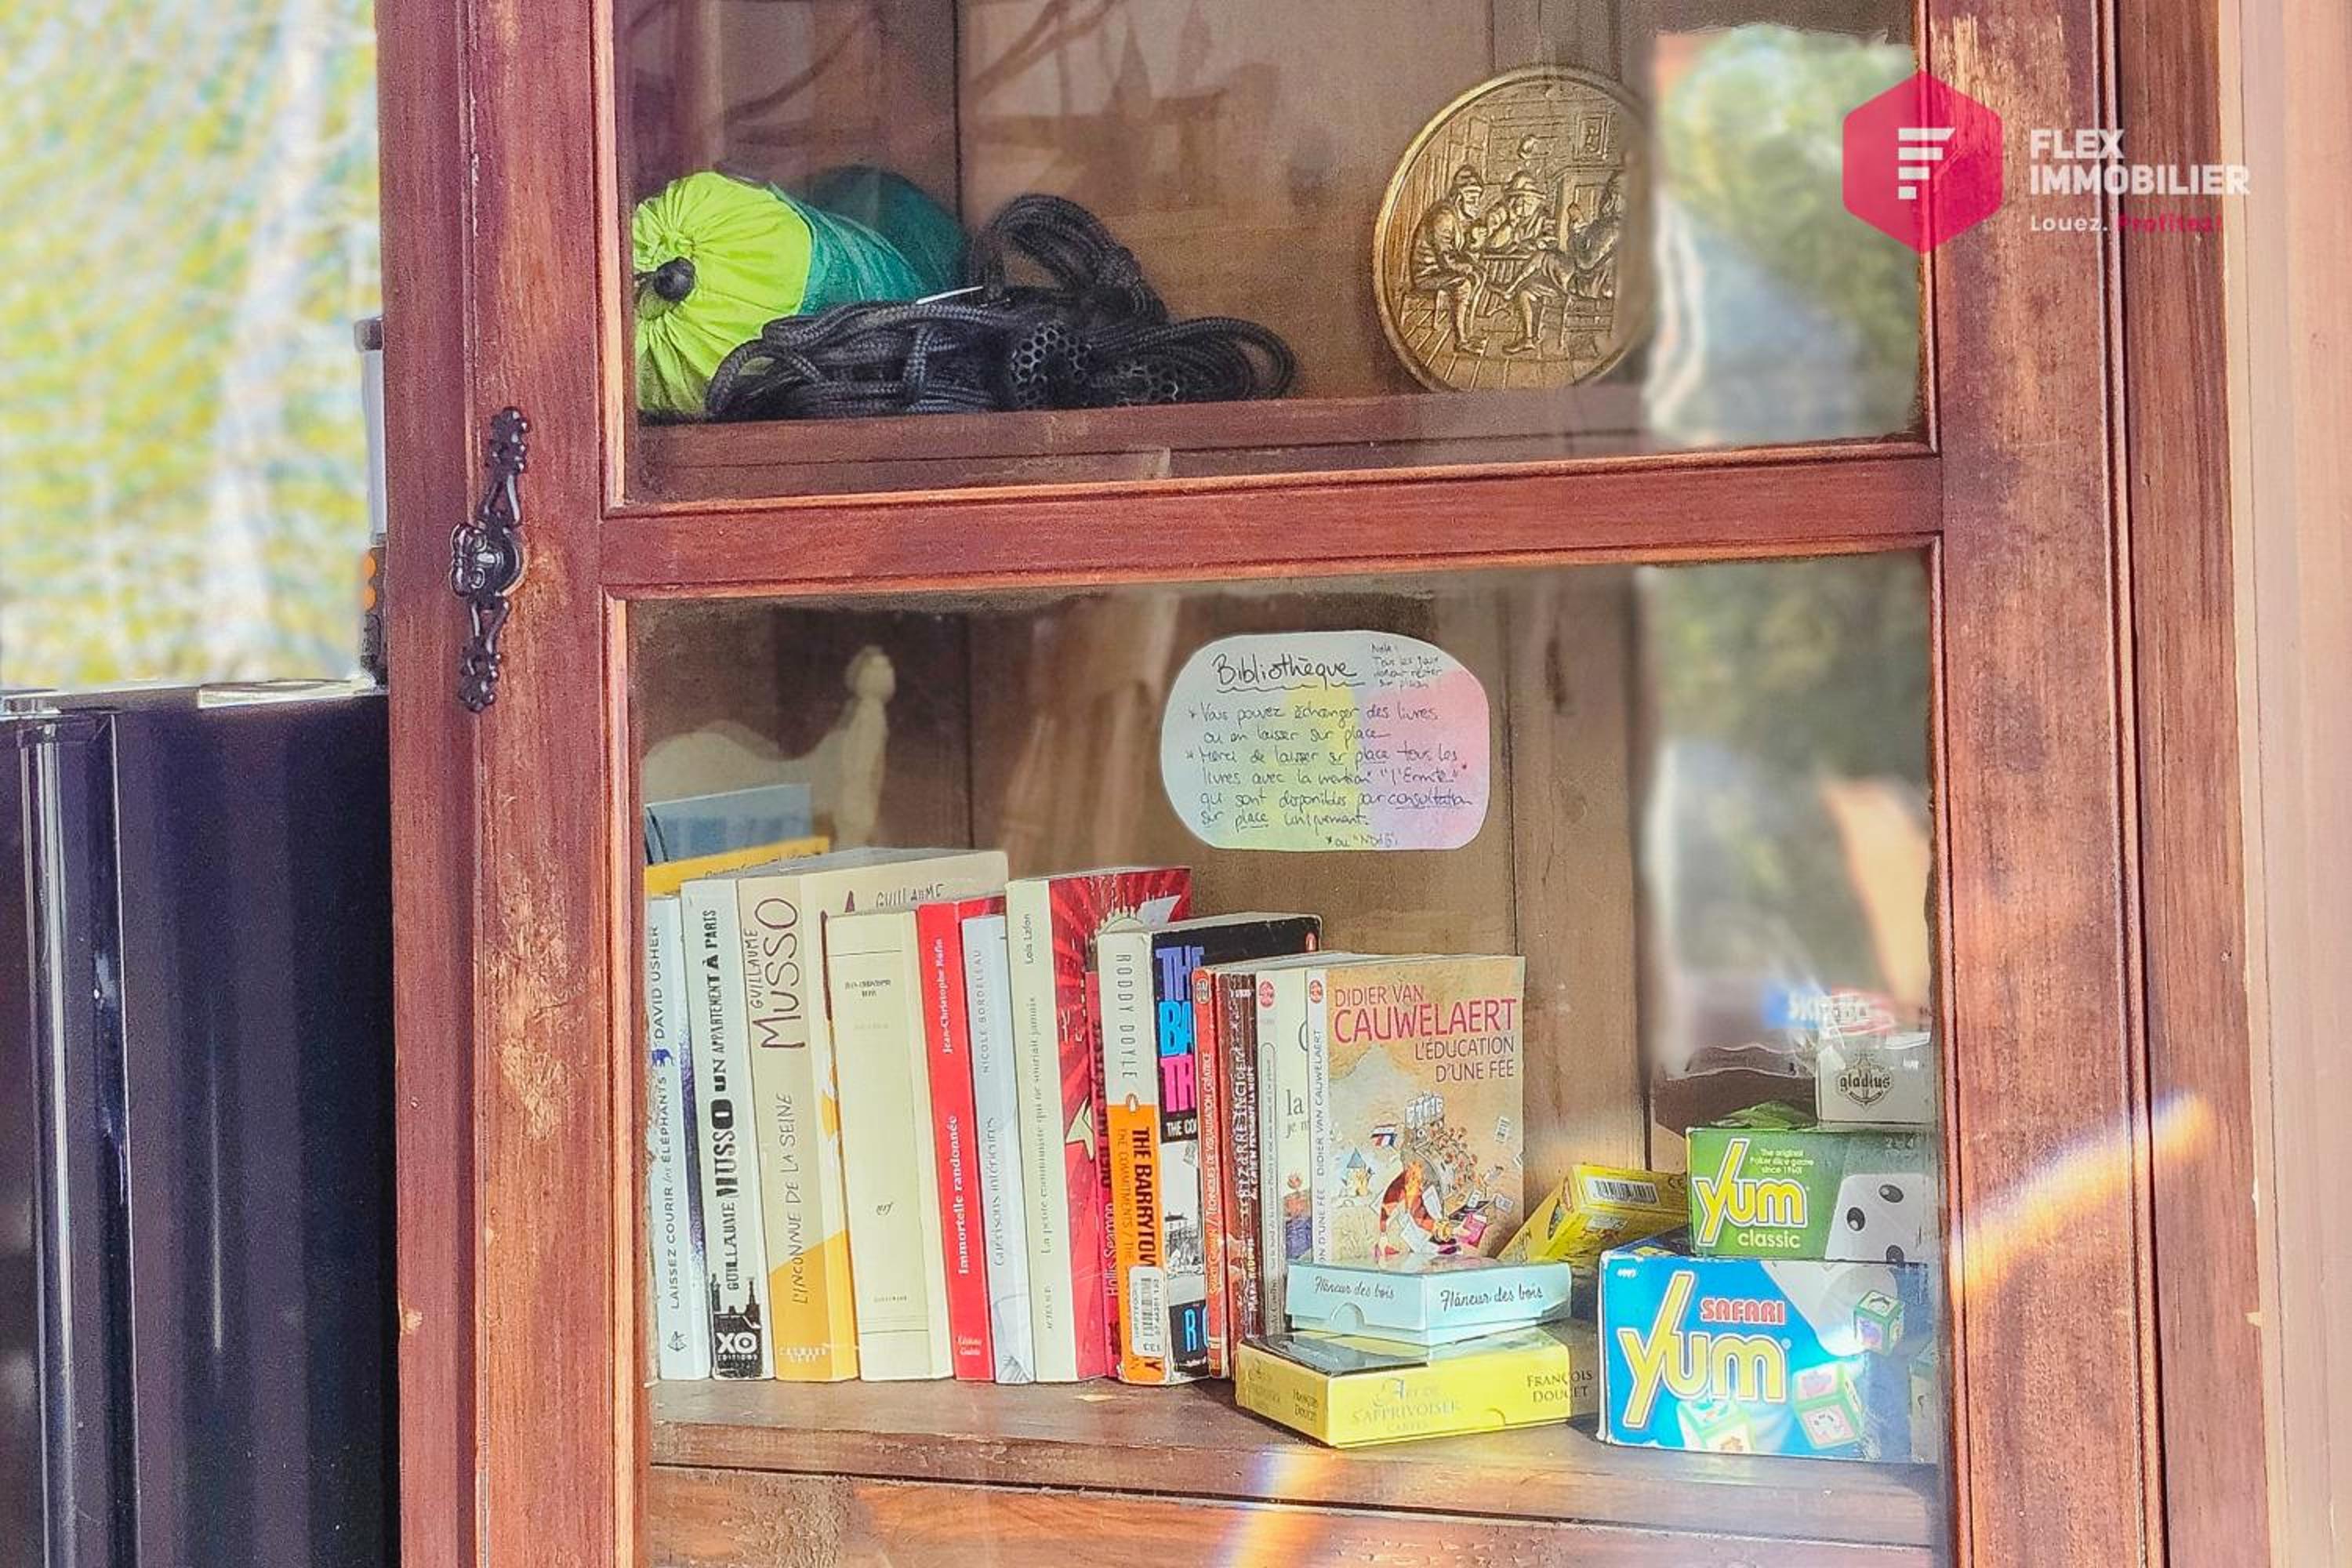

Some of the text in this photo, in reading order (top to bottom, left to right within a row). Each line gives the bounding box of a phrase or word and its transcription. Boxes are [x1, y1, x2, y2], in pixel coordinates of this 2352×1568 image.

[1367, 704, 1388, 719] des
[1250, 750, 1265, 764] de
[1252, 771, 1287, 783] avec
[1298, 768, 1312, 782] la
[1236, 787, 1268, 808] sont
[702, 910, 717, 949] PARIS
[648, 926, 666, 1040] DAVID USHER
[744, 928, 764, 1010] GUILLAUME
[752, 897, 806, 1049] MUSSO
[1334, 983, 1424, 1008] DIDIER VAN
[707, 974, 726, 1054] APPARTEMENT
[1116, 953, 1138, 1080] RODDY DOYLE
[1334, 998, 1517, 1044] CAUWELAERT
[1414, 1036, 1514, 1061] L'ÉDUCATION
[713, 1059, 727, 1092] UN
[1436, 1062, 1484, 1083] D'UNE
[1839, 1072, 1891, 1091] gladius
[1287, 1089, 1305, 1116] la
[1313, 1029, 1325, 1177] DIDIER VAN CAUWELAERT
[1132, 1126, 1152, 1159] THE
[1166, 1120, 1182, 1137] THE
[710, 1099, 740, 1291] GUILLAUME MUSSO
[775, 1093, 809, 1305] L'INCONNUE DE LA SEINE
[665, 1188, 677, 1243] COURIR
[952, 1195, 969, 1275] Immortelle
[1737, 1226, 1802, 1250] classic
[670, 1246, 680, 1310] LAISSEZ
[1104, 1263, 1117, 1297] Hollis
[1354, 1280, 1371, 1297] des
[1374, 1283, 1395, 1300] bois
[1494, 1285, 1515, 1303] des
[1518, 1282, 1544, 1301] bois
[1700, 1298, 1786, 1325] SAFARI
[716, 1332, 757, 1354] XO
